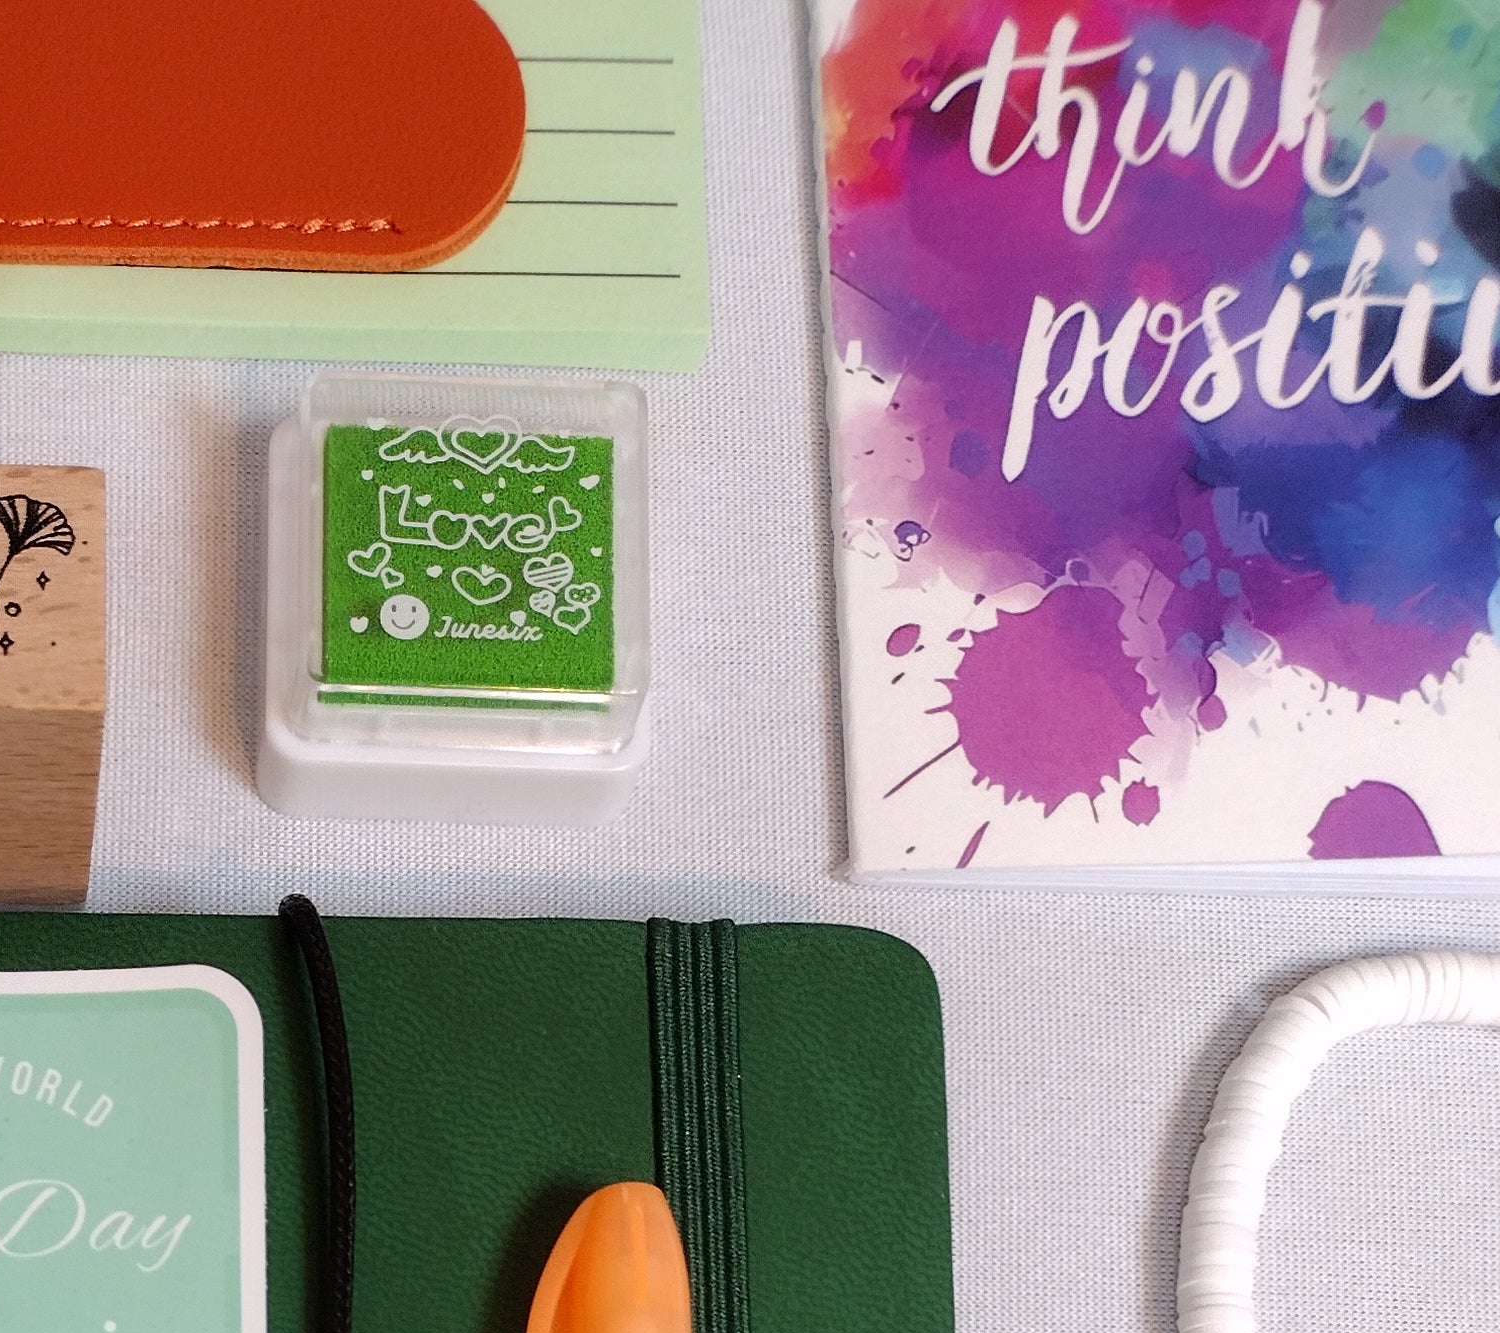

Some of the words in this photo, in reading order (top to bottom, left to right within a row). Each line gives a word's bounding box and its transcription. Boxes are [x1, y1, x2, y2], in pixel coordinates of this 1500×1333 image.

[930, 0, 1380, 234] think
[378, 484, 552, 553] Love
[434, 616, 544, 641] Junesix
